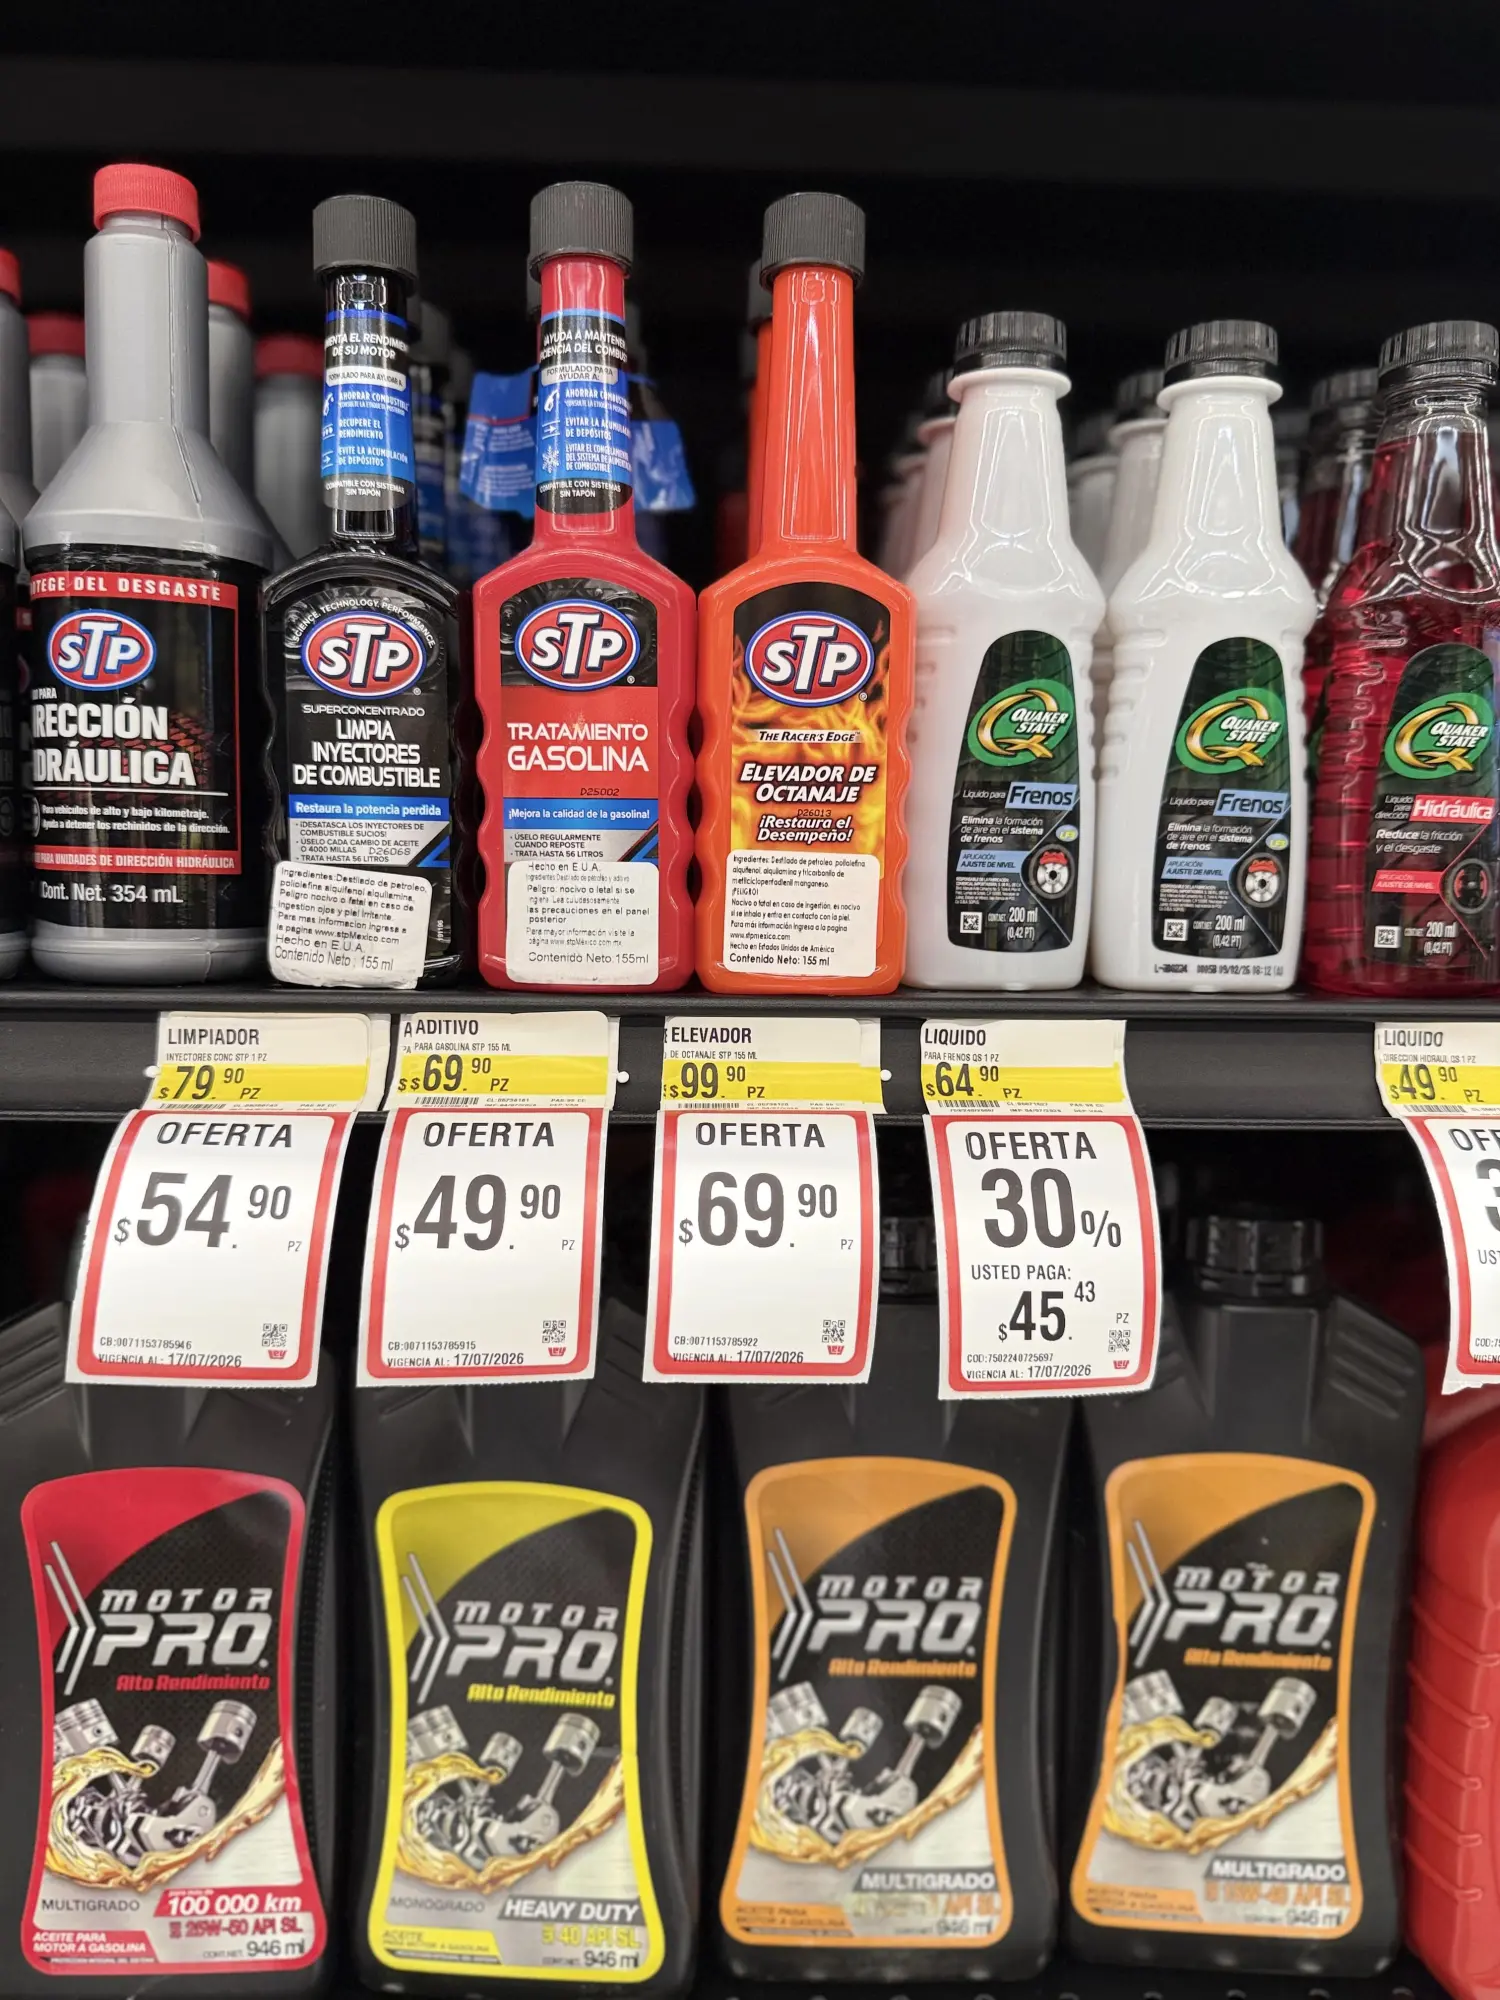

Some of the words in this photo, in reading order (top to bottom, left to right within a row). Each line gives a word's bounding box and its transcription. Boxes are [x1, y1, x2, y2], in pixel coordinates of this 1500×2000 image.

[74, 577, 107, 592] DEL
[118, 578, 221, 601] DESGASTE
[293, 612, 321, 643] SCIENCE.
[320, 599, 380, 614] TECHNOLOGY.
[382, 602, 436, 648] PERFORMANCE.
[58, 621, 144, 679] STP
[531, 612, 627, 679] STP
[318, 623, 413, 687] STP
[762, 624, 861, 694] STP
[301, 704, 425, 716] SUPERCONCENTRADO
[1011, 708, 1069, 724] QUAKER
[336, 719, 395, 740] LIMPIA
[507, 723, 648, 741] TRATAMIENTO
[1016, 722, 1058, 735] STATE
[1219, 716, 1280, 733] QUAKER
[1429, 721, 1488, 738] QUAKER
[1226, 731, 1269, 743] STATE
[1436, 735, 1480, 747] STATE
[311, 742, 420, 764] INYECTORES
[508, 745, 649, 772] GASOLINA
[293, 764, 317, 785] DE
[320, 765, 440, 788] COMBUSTIBLE
[740, 763, 844, 782] ELEVADOR
[849, 765, 877, 782] DE
[580, 788, 619, 796] D25002
[755, 783, 860, 802] OCTANAJE
[1009, 786, 1073, 806] Frenos
[296, 802, 341, 814] Restaura
[344, 803, 353, 814] la
[356, 805, 400, 816] potencia
[403, 805, 442, 817] perdida
[1218, 793, 1283, 814] Frenos
[1414, 799, 1493, 820] Hidráulica
[508, 808, 540, 820] ¡Mejora
[542, 810, 551, 818] la
[553, 809, 585, 818] calidad
[587, 809, 597, 818] de
[600, 810, 608, 818] la
[611, 809, 650, 820] gasolina!
[797, 809, 832, 817] D26013
[759, 815, 833, 829] ¡Restaura
[837, 816, 851, 829] el
[757, 829, 854, 843] Desempeño!
[40, 881, 69, 900] Cont.
[72, 883, 106, 901] Net.
[112, 885, 147, 902] 354
[154, 885, 183, 903] mL
[730, 953, 774, 964] Contenido
[777, 955, 800, 965] Neto:
[803, 956, 817, 965] 155
[819, 957, 830, 966] ml
[416, 1020, 479, 1035] ADITIVO
[671, 1027, 752, 1043] ELEVADOR
[168, 1029, 259, 1045] LIMPIADOR
[924, 1028, 986, 1046] LIQUIDO
[1384, 1030, 1444, 1048] LIQUIDO
[415, 1043, 433, 1051] PARA
[436, 1043, 469, 1051] GASOLINA
[472, 1043, 485, 1051] STP
[488, 1043, 499, 1051] 155
[681, 1051, 715, 1059] OCTANAJE
[719, 1051, 731, 1059] STP
[166, 1053, 212, 1061] INYECTORES
[252, 1054, 255, 1062] 1
[258, 1054, 267, 1062] PZ
[924, 1052, 941, 1060] PARA
[943, 1052, 970, 1061] FRENOS
[973, 1054, 982, 1062] QS
[985, 1054, 987, 1062] 1
[990, 1054, 999, 1062] PZ
[1382, 1053, 1418, 1062] DIRECCION
[1467, 1055, 1476, 1063] PZ
[490, 1079, 509, 1091] PZ
[747, 1087, 765, 1098] PZ
[1003, 1088, 1022, 1099] PZ
[240, 1088, 261, 1100] PZ
[1464, 1089, 1484, 1102] PZ
[157, 1122, 292, 1147] OFERTA
[423, 1122, 554, 1147] OFERTA
[696, 1122, 825, 1147] OFERTA
[965, 1131, 1097, 1160] OFERTA
[981, 1168, 1122, 1248] 30%
[562, 1239, 575, 1250] PZ
[971, 1265, 1020, 1280] USTED
[1027, 1265, 1071, 1280] PAGA:
[1116, 1313, 1129, 1324] PZ
[98, 1354, 144, 1364] VIGENCIA
[169, 1354, 242, 1368] 17/07/2026
[387, 1357, 430, 1367] VIGENCIA
[434, 1357, 450, 1367] AL:
[453, 1353, 524, 1366] 17/07/2026
[672, 1352, 714, 1363] VIGENCIA
[718, 1354, 732, 1362] AL:
[737, 1350, 803, 1364] 17/07/2026
[966, 1369, 1006, 1379] VIGENCIA
[1010, 1369, 1023, 1379] AL:
[1028, 1365, 1091, 1378] 17/07/2026
[817, 1575, 983, 1599] MOTOR
[1174, 1566, 1340, 1594] MOTOR
[99, 1588, 272, 1612] MOTOR
[453, 1601, 618, 1630] MOTOR
[116, 1674, 154, 1691] Alto
[156, 1674, 270, 1691] Rendimiento
[1212, 1860, 1346, 1880] MULTIGRADO
[861, 1872, 996, 1889] MULTIGRADO
[41, 1900, 140, 1911] MULTIGRADO
[168, 1897, 210, 1916] 100
[215, 1895, 258, 1912] 000
[264, 1894, 301, 1912] km
[505, 1898, 576, 1919] HEAVY
[579, 1902, 638, 1920] DUTY
[247, 1940, 281, 1957] 946
[285, 1940, 305, 1956] ml
[584, 1951, 617, 1967] 946
